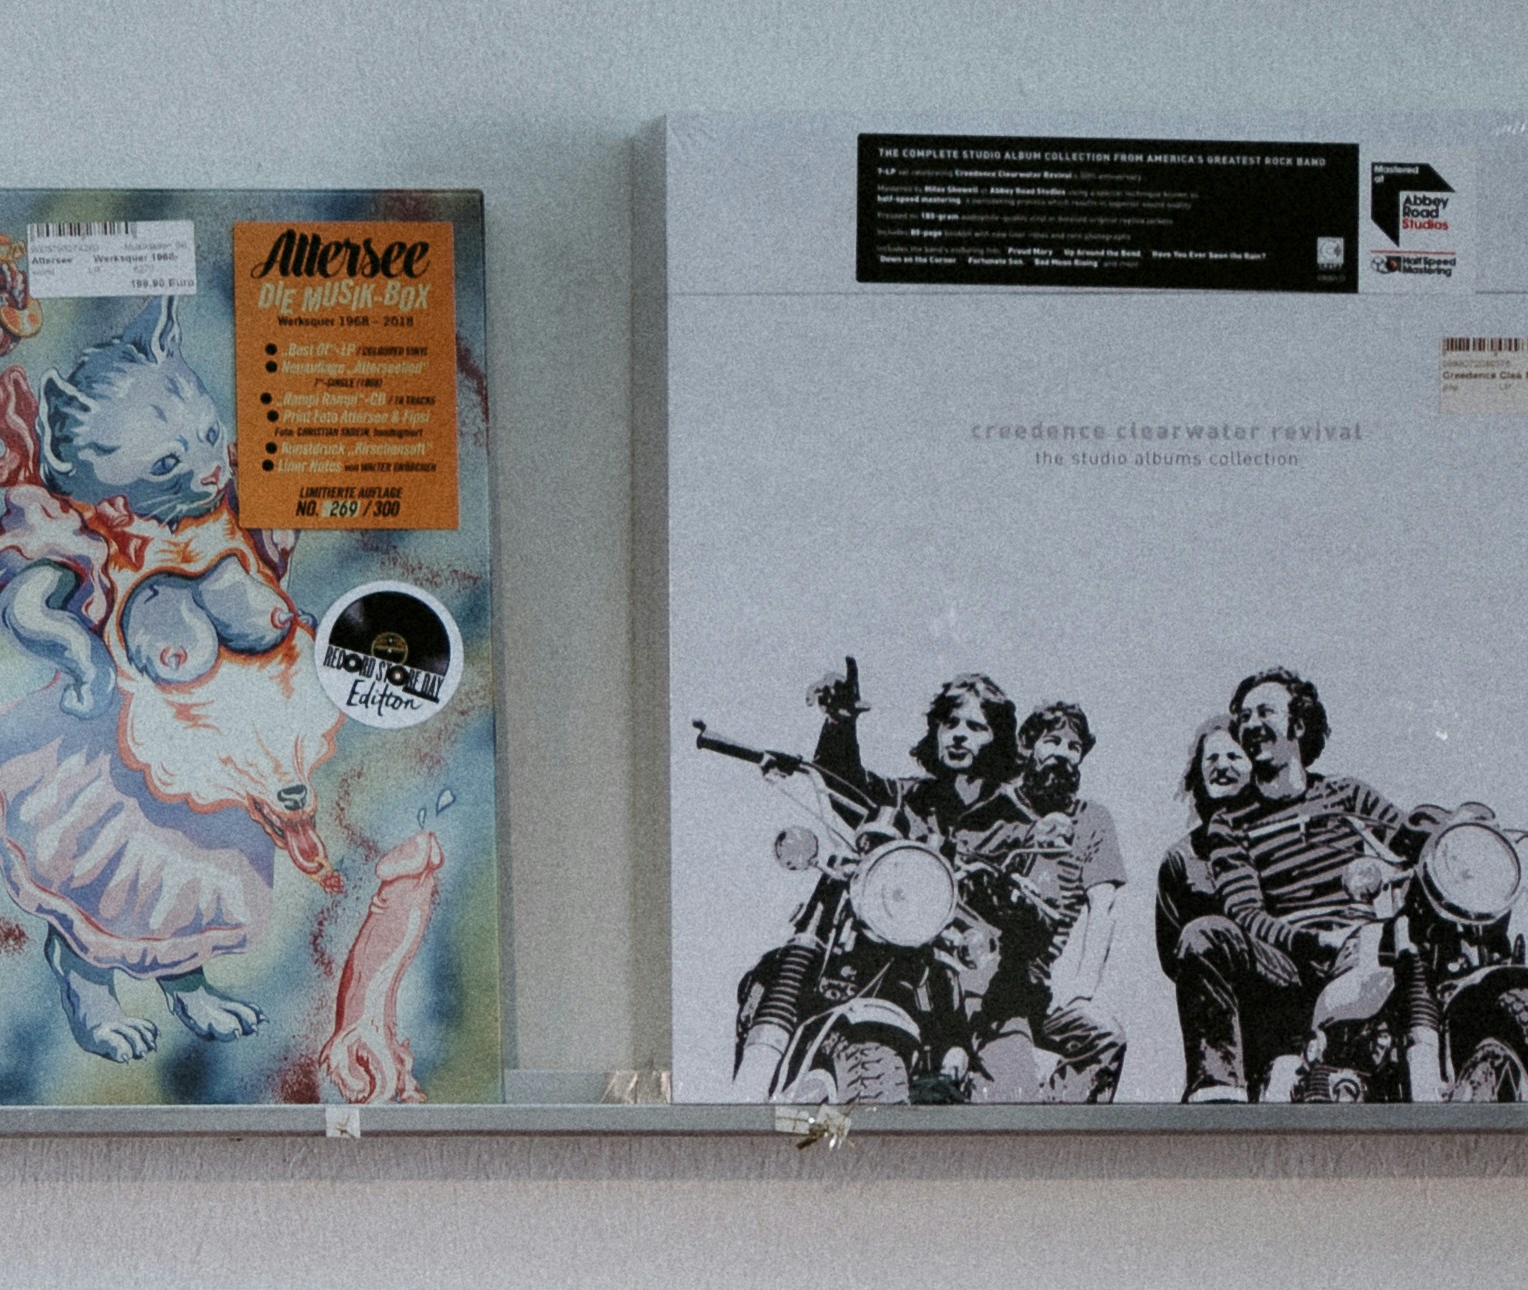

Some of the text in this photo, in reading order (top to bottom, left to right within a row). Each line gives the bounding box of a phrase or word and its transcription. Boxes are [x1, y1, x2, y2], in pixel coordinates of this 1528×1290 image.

[878, 148, 899, 159] THE
[902, 149, 959, 159] COMPLETE
[962, 150, 1001, 160] STUDIO
[1004, 150, 1041, 160] ALBUM
[1044, 151, 1110, 162] COLLECTION
[1113, 153, 1144, 163] FROM
[1207, 155, 1261, 165] GREATEST
[1265, 156, 1293, 166] ROCK
[1296, 157, 1326, 167] BAND
[1403, 195, 1449, 210] Abbey
[1403, 207, 1439, 218] Road
[1402, 219, 1448, 231] Studios
[258, 280, 296, 314] DIE
[277, 315, 414, 329] Werksquer 1968 2018
[970, 421, 1363, 441] creedence clearwater revival
[1034, 451, 1299, 467] the studio albums collection
[299, 486, 403, 499] LIMITIERTE AUFLAGE
[295, 501, 319, 517] NO.
[330, 501, 359, 516] 269
[373, 501, 400, 517] 300
[323, 645, 445, 698] RECORD STORE DAY
[346, 679, 423, 717] Edition
